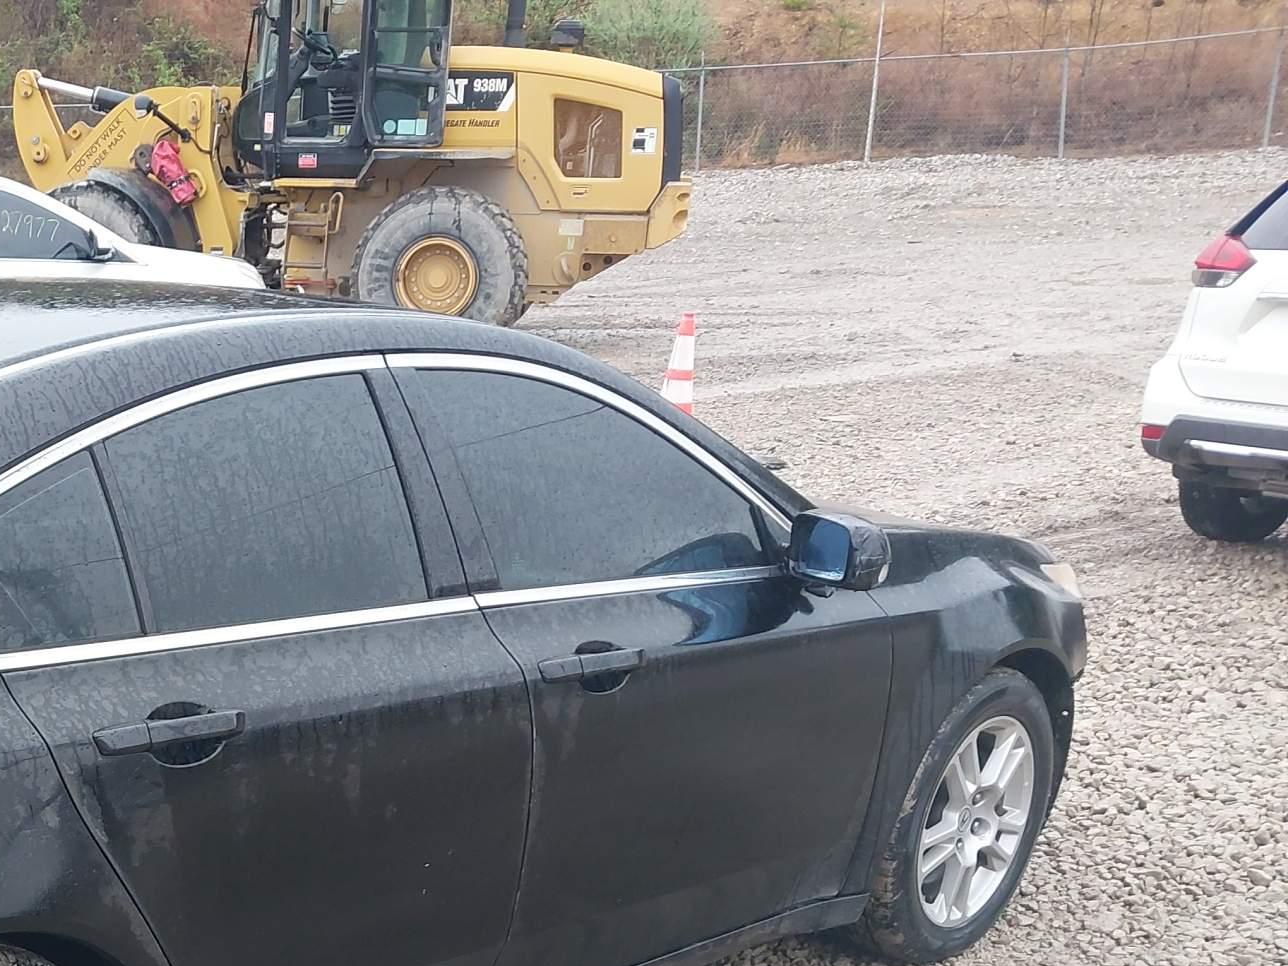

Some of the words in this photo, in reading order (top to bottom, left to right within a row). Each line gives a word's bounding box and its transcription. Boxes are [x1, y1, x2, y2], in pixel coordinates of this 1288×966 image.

[473, 78, 508, 92] 938M
[445, 119, 467, 127] EGATE
[467, 118, 501, 128] HANDLER
[74, 159, 87, 173] DO
[86, 140, 102, 160] NOT
[101, 117, 124, 141] WALK
[87, 148, 109, 169] NDER
[108, 127, 128, 150] MAST
